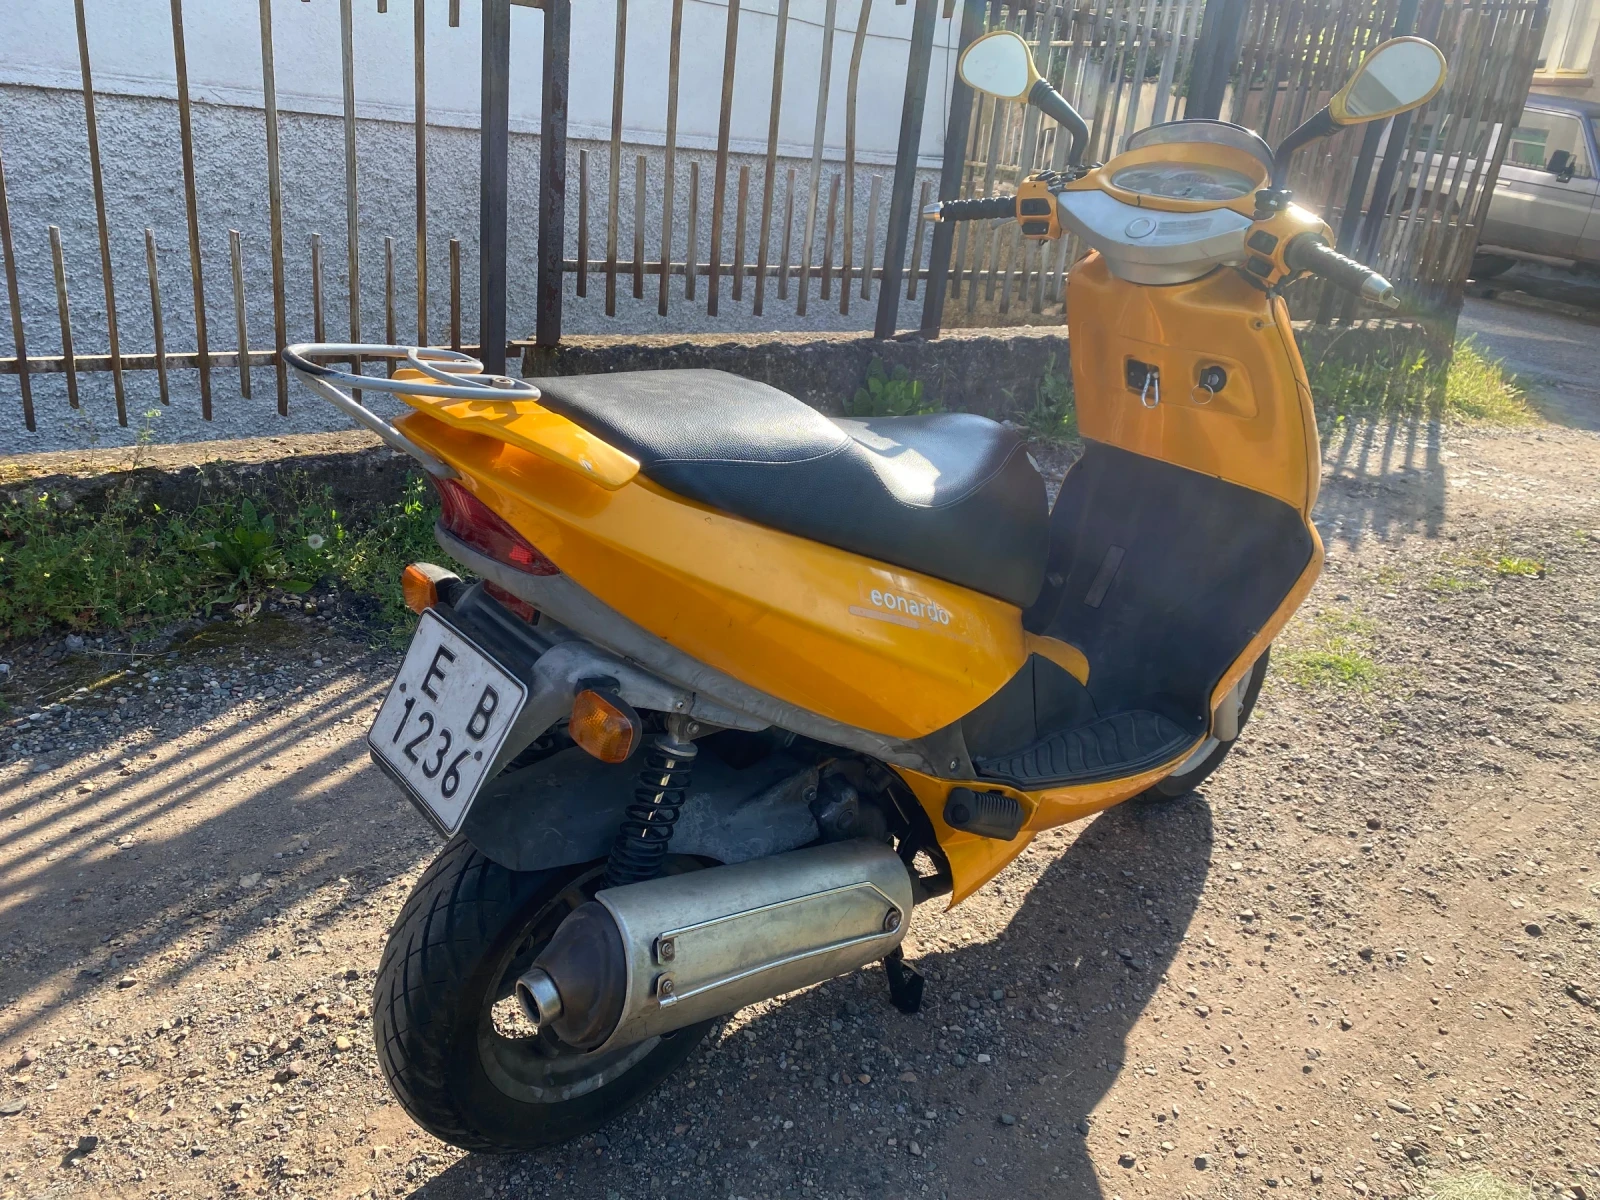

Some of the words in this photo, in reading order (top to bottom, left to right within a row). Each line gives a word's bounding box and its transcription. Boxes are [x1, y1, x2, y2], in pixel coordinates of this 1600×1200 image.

[421, 644, 457, 702] E
[465, 683, 500, 741] B
[392, 696, 472, 799] 1236
